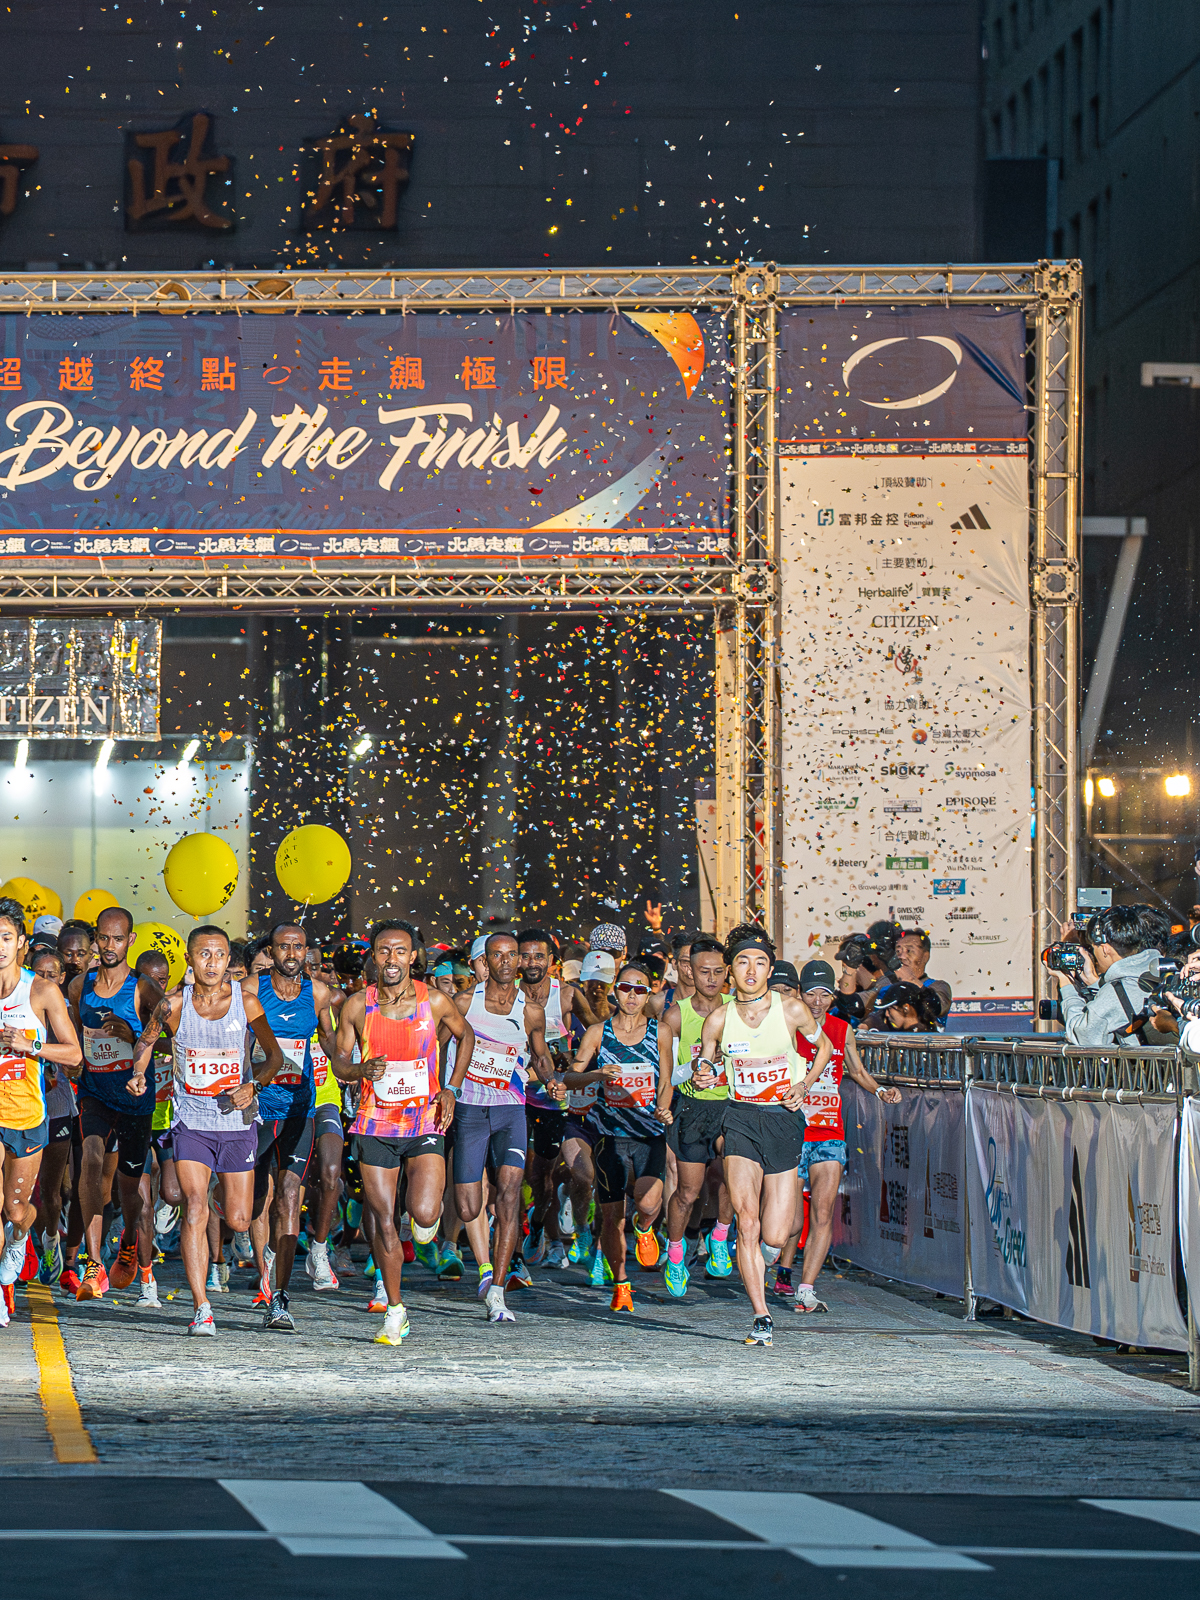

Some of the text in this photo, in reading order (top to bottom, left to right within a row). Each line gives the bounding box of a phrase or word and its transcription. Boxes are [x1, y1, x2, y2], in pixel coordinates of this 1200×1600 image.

[318, 355, 568, 393] 走飆極限
[378, 402, 568, 491] Finish
[839, 513, 899, 526] 富邦金控
[858, 586, 909, 598] Herbalife
[871, 615, 939, 628] CITIZEN
[932, 729, 981, 738] 台灣大哥大
[881, 764, 926, 777] SHOKZ
[945, 797, 996, 806] EPISODE
[223, 882, 236, 896] 42
[152, 931, 176, 964] 42 KM
[98, 1044, 111, 1052] 10
[93, 1051, 119, 1060] SHERIF
[189, 1063, 240, 1074] 11308
[738, 1067, 788, 1083] 11657
[398, 1078, 405, 1086] 4
[387, 1086, 416, 1095] ABEBE
